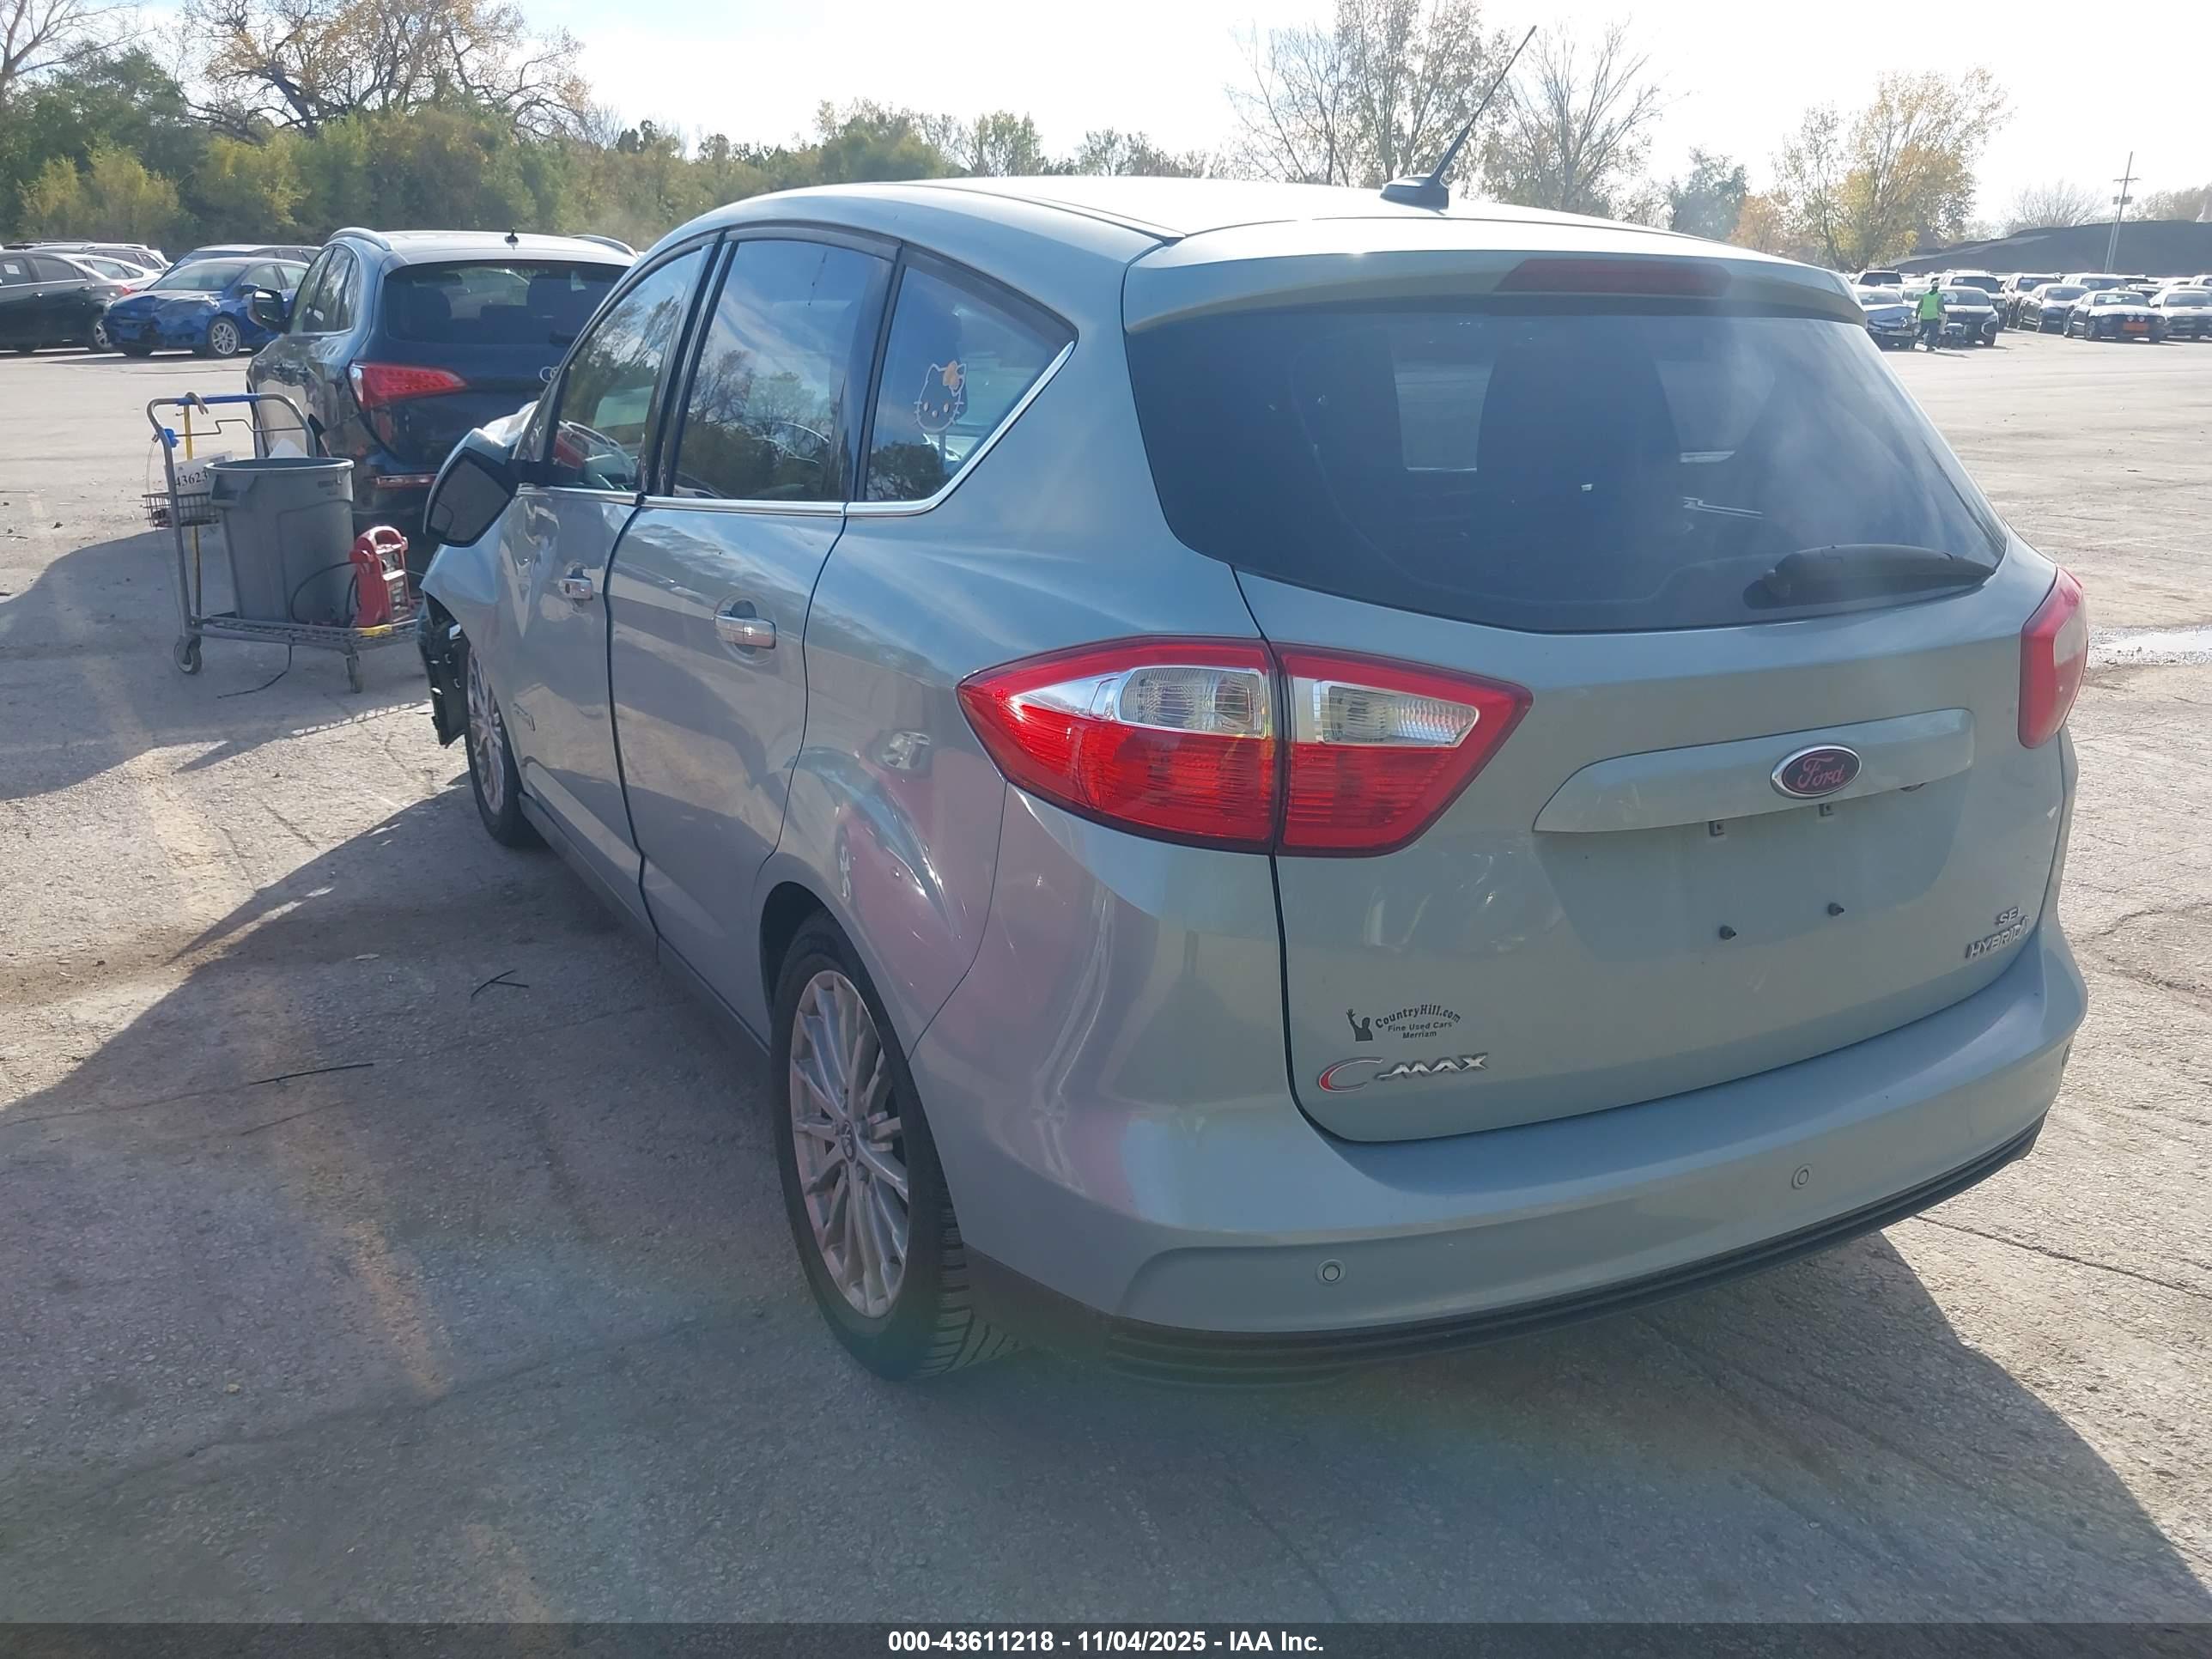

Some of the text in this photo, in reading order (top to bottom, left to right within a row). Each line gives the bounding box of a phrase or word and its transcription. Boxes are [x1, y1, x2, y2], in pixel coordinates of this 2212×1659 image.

[1798, 757, 1844, 788] Ford
[1966, 922, 2024, 959] HYBRID
[1376, 1004, 1461, 1029] CountryHill.com
[1388, 1024, 1406, 1032] Fine
[1409, 1023, 1431, 1031] Used
